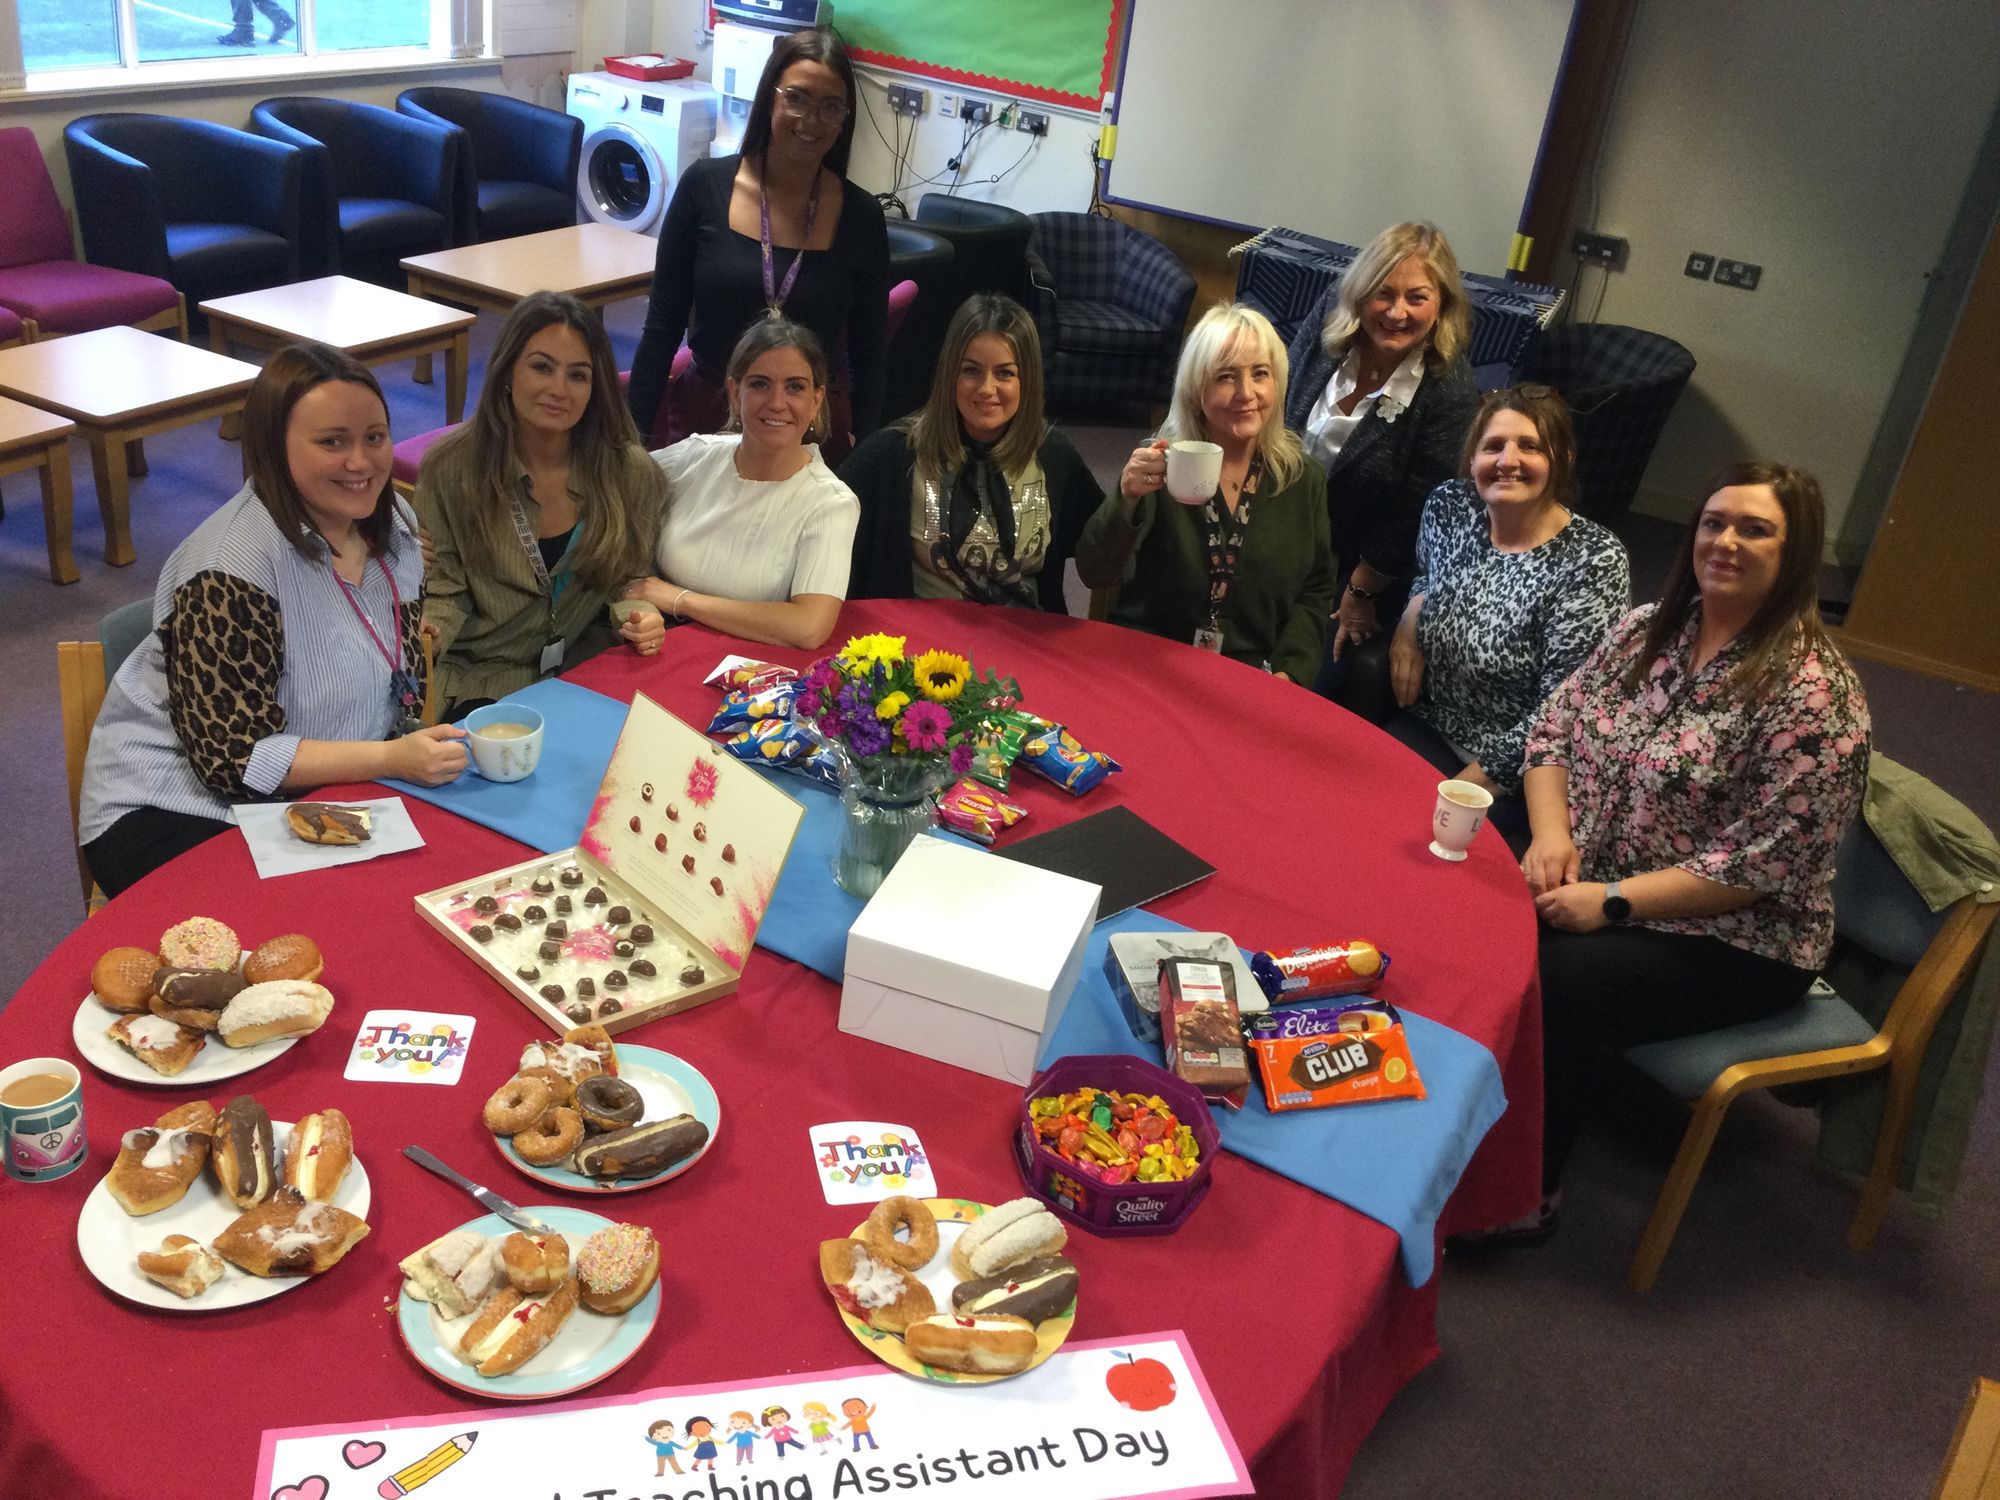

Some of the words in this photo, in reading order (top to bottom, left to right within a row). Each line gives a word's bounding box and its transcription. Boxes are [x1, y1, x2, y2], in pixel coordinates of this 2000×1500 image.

[959, 797, 993, 812] WALKERS
[1285, 945, 1344, 974] Digtives
[367, 1025, 467, 1048] Thank
[1284, 1014, 1330, 1038] Elite
[375, 1047, 450, 1067] you!
[1265, 1045, 1274, 1059] 7
[1306, 1043, 1368, 1082] CLUB
[1352, 1076, 1379, 1089] Orange
[819, 1138, 922, 1161] Thank
[843, 1158, 914, 1184] you!
[1116, 1200, 1167, 1213] Quality
[1118, 1211, 1158, 1222] Street
[582, 1472, 812, 1500] hing
[832, 1436, 1067, 1498] Assistant
[1073, 1427, 1169, 1466] Day
